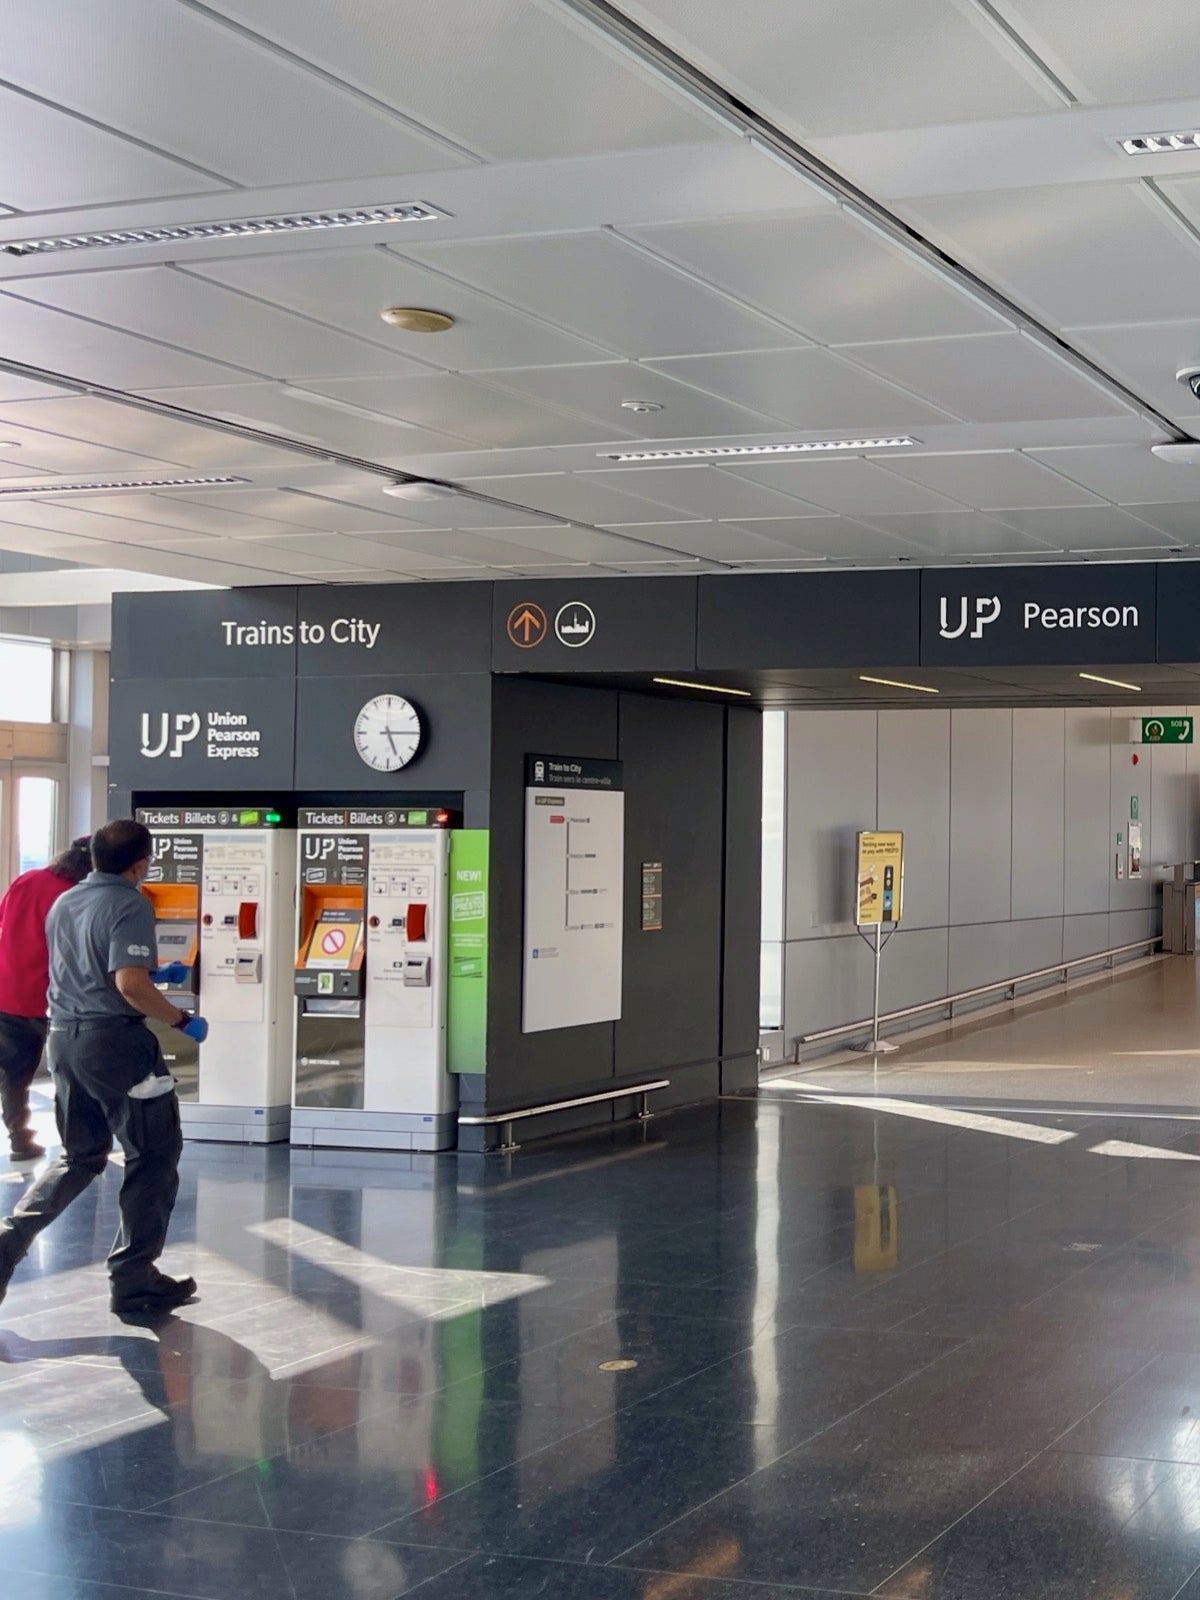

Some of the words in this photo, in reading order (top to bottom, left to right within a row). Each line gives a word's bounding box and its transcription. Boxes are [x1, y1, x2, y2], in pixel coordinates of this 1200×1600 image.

[939, 596, 1001, 639] UP
[1024, 602, 1139, 629] Pearson
[222, 620, 294, 646] Trains
[299, 623, 326, 645] to
[331, 618, 380, 649] City
[208, 711, 248, 726] Union
[140, 711, 201, 758] UP
[208, 729, 261, 743] Pearson
[207, 745, 260, 761] Express
[549, 763, 563, 772] Train
[570, 764, 582, 774] City
[143, 812, 179, 824] Tickets
[185, 812, 217, 824] Billets
[231, 814, 238, 822] &
[305, 812, 344, 825] Tickets
[350, 812, 383, 825] Billets
[399, 814, 406, 822] &
[305, 837, 335, 860] UP
[338, 853, 363, 861] Express
[456, 870, 482, 881] NEW!
